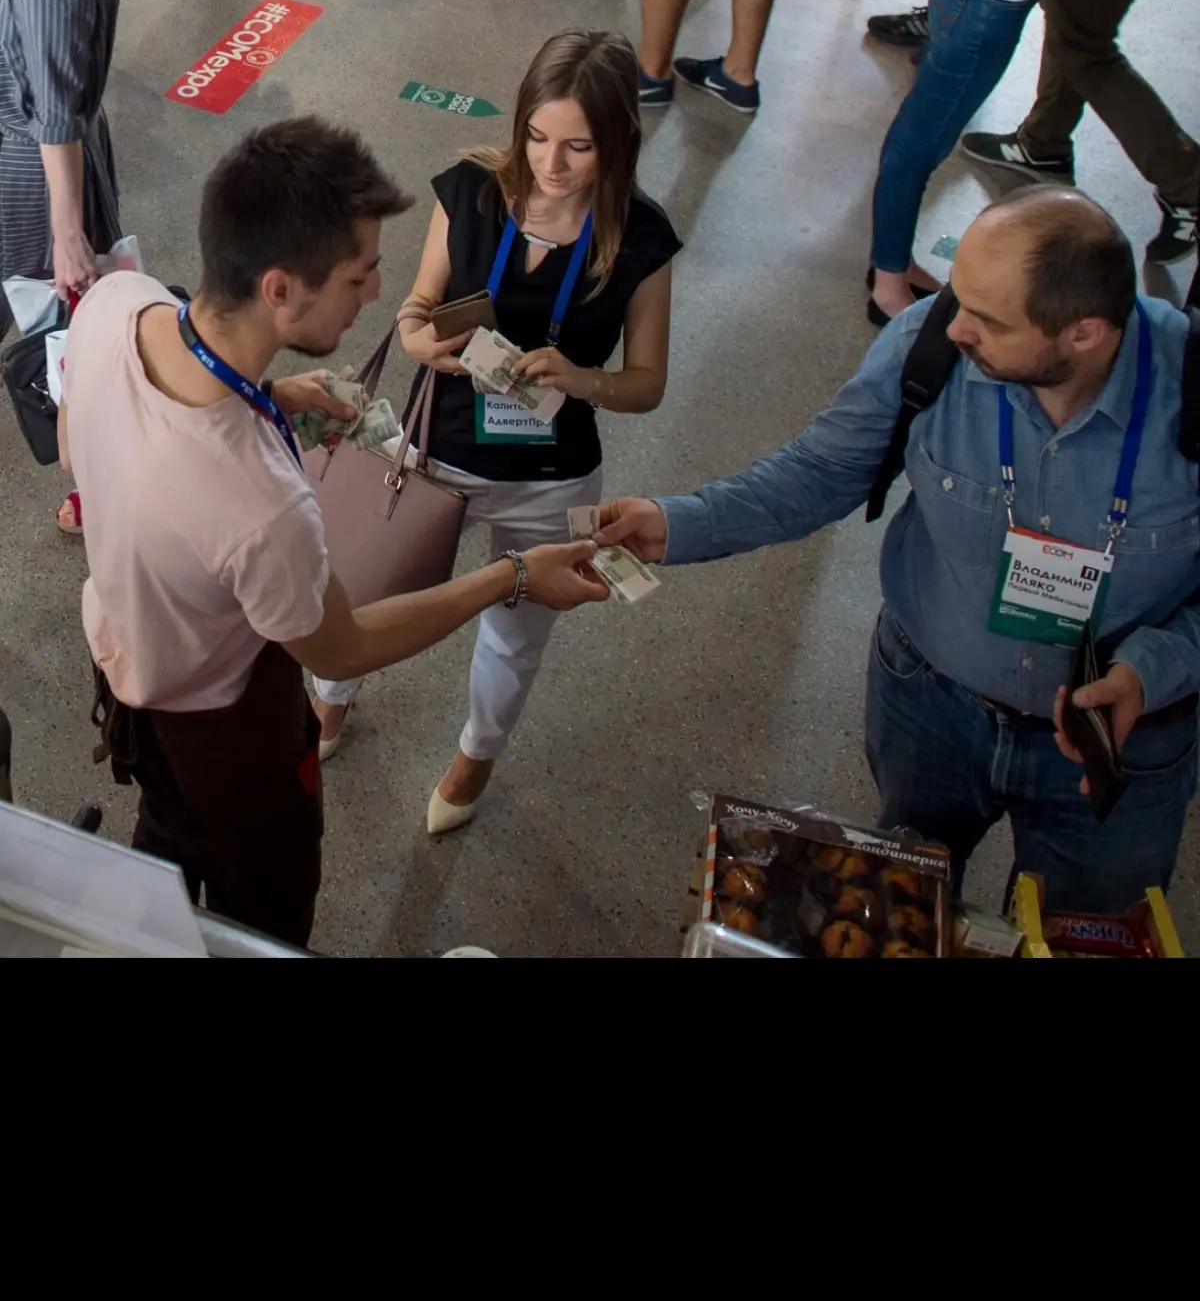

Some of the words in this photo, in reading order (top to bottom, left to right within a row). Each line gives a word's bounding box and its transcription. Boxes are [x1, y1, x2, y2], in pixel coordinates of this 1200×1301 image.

[177, 2, 291, 99] #ECOMexpo
[486, 401, 529, 411] Капито
[1010, 572, 1056, 593] Пляко
[1013, 559, 1093, 592] Владимир
[725, 803, 799, 831] Хочу-Хочу
